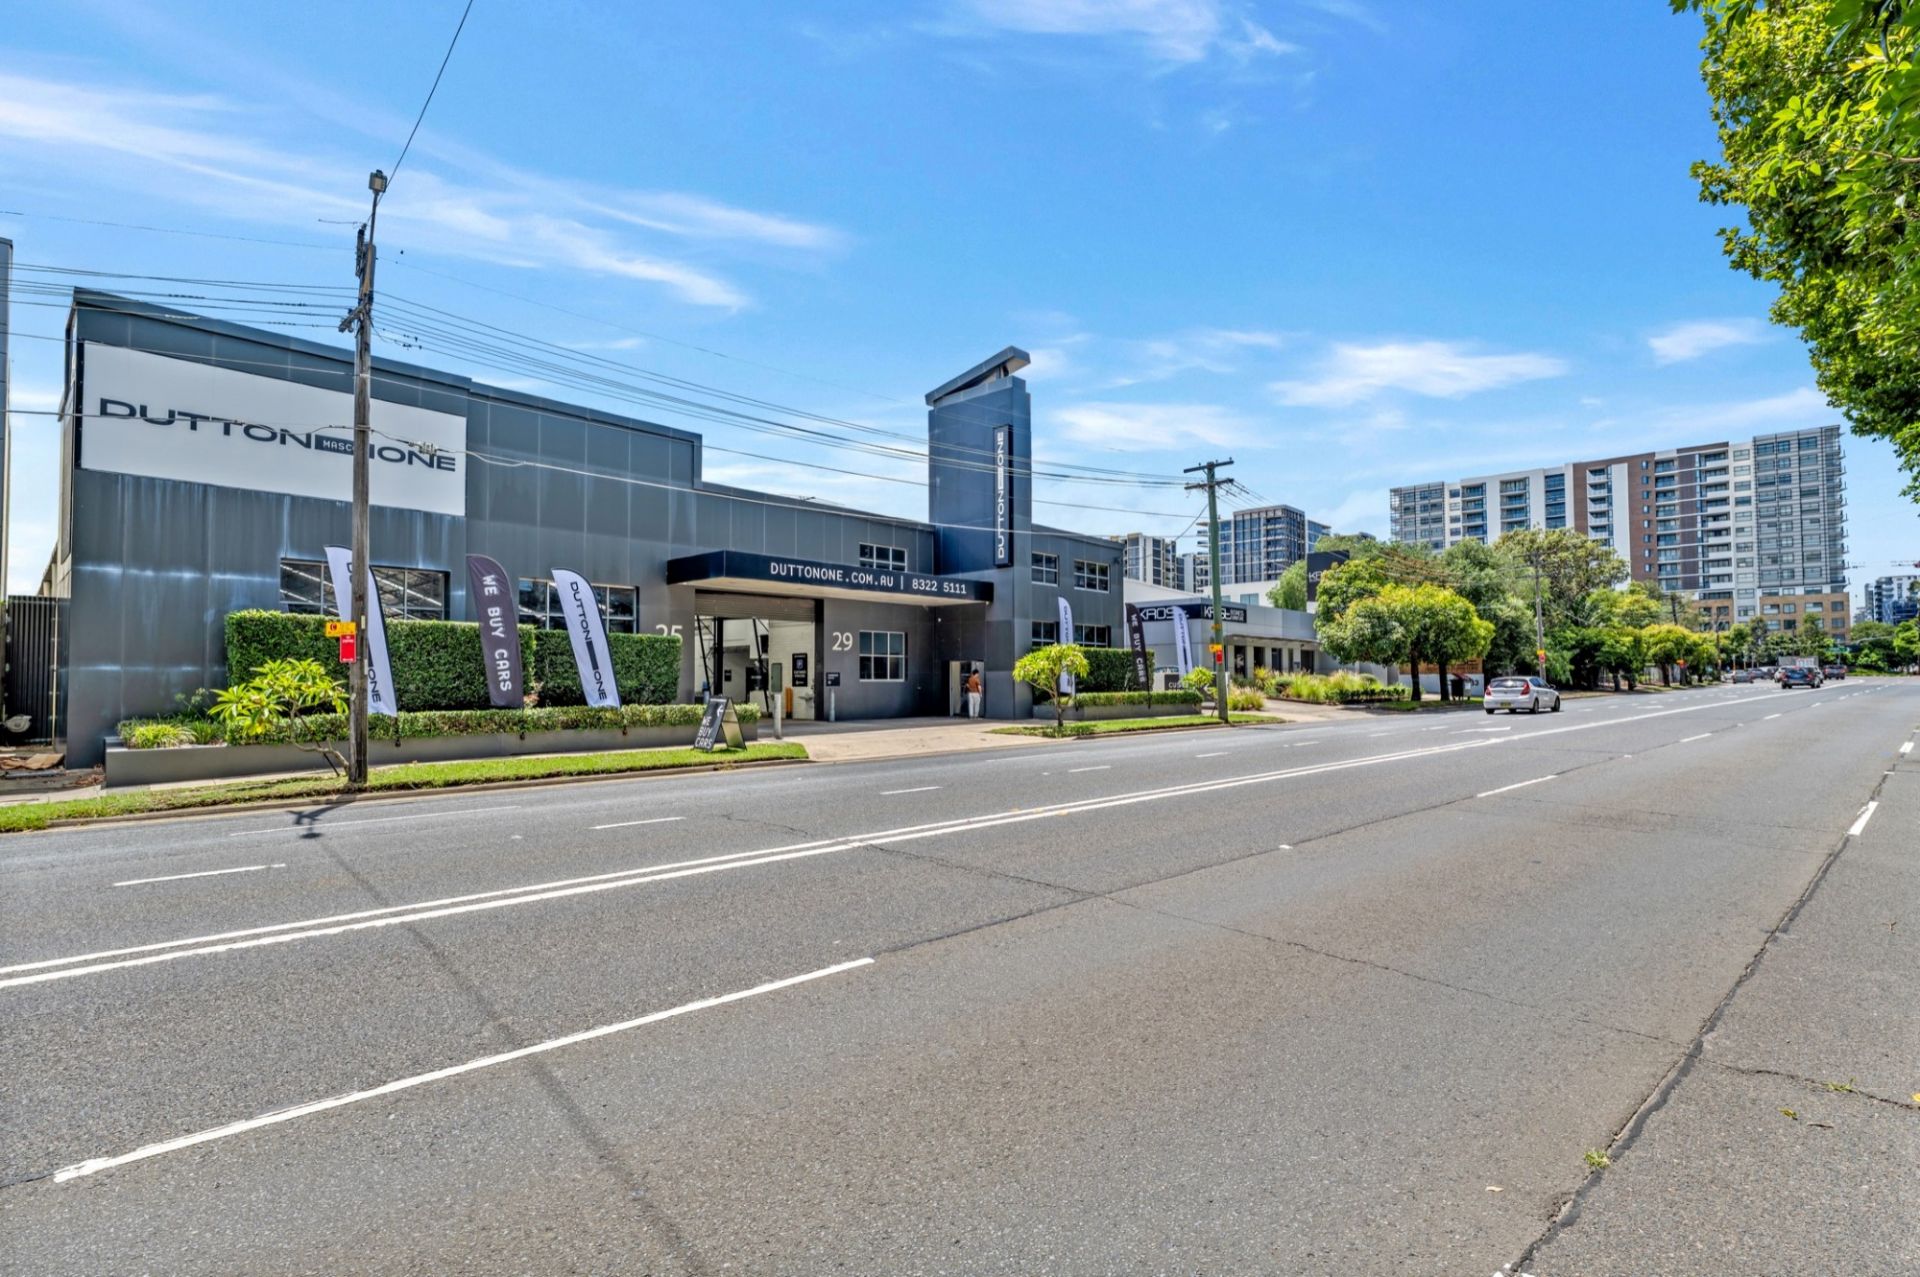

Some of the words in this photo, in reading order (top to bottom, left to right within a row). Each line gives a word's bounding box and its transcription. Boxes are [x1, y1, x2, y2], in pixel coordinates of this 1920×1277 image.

[100, 397, 311, 450] DUTTON
[377, 446, 456, 472] ONE
[482, 574, 498, 596] WE
[770, 562, 894, 587] DUTTONONE.COM.AU
[912, 579, 937, 591] 8322
[943, 582, 967, 594] 5111
[487, 606, 505, 638] BUY
[570, 581, 592, 641] DUTTON
[593, 670, 607, 700] ONE
[832, 631, 853, 651] 29
[494, 649, 512, 692] CARS
[695, 737, 713, 749] CARS
[698, 726, 713, 737] BUY
